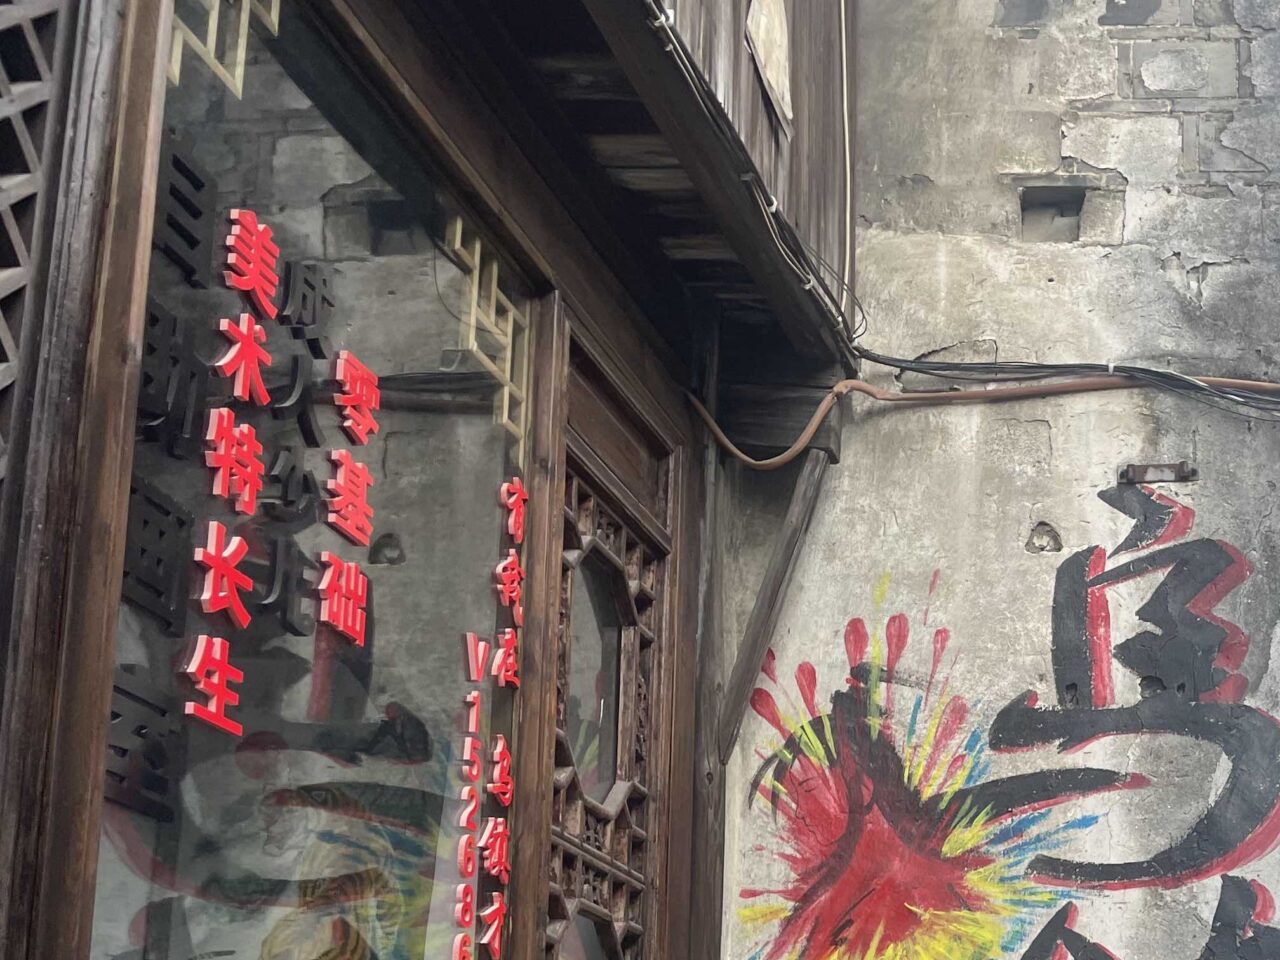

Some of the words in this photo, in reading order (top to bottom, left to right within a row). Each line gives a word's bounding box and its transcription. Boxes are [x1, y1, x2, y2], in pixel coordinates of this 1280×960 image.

[185, 208, 280, 737] 美术特长生
[318, 349, 381, 648] 零基础
